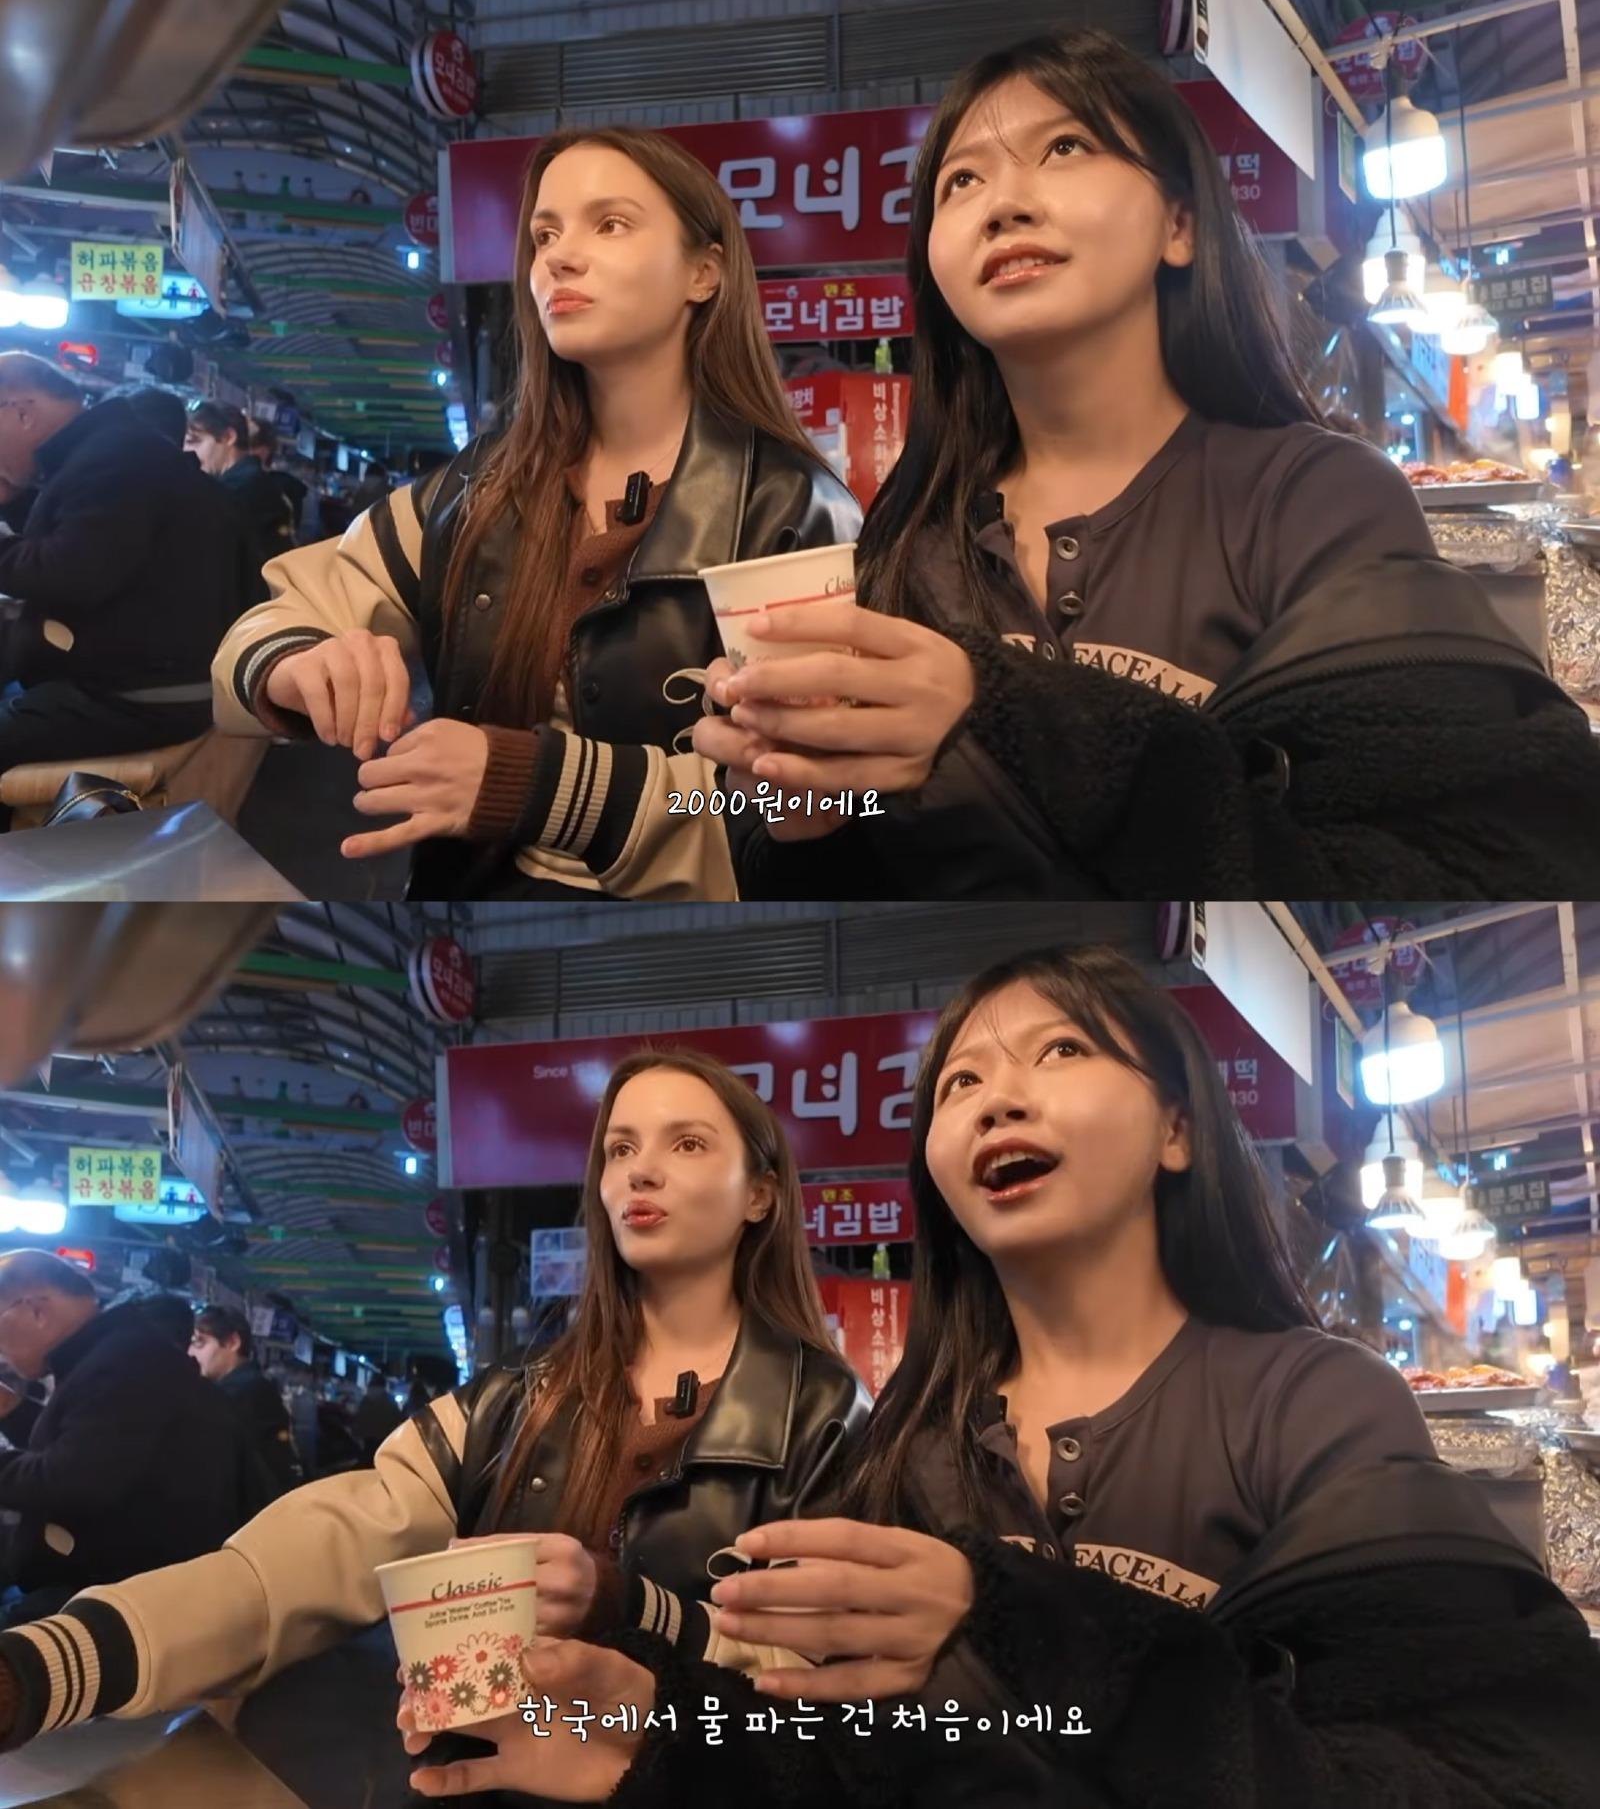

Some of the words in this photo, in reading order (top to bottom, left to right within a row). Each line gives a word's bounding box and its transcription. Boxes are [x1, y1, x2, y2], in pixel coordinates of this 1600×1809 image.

[77, 249, 158, 273] 허파볶음
[78, 272, 158, 296] 곱창볶음
[765, 296, 904, 333] 모녀김밥
[74, 1154, 156, 1178] 허파볶음
[75, 1177, 156, 1201] 곱창볶음
[431, 1571, 502, 1602] Classic
